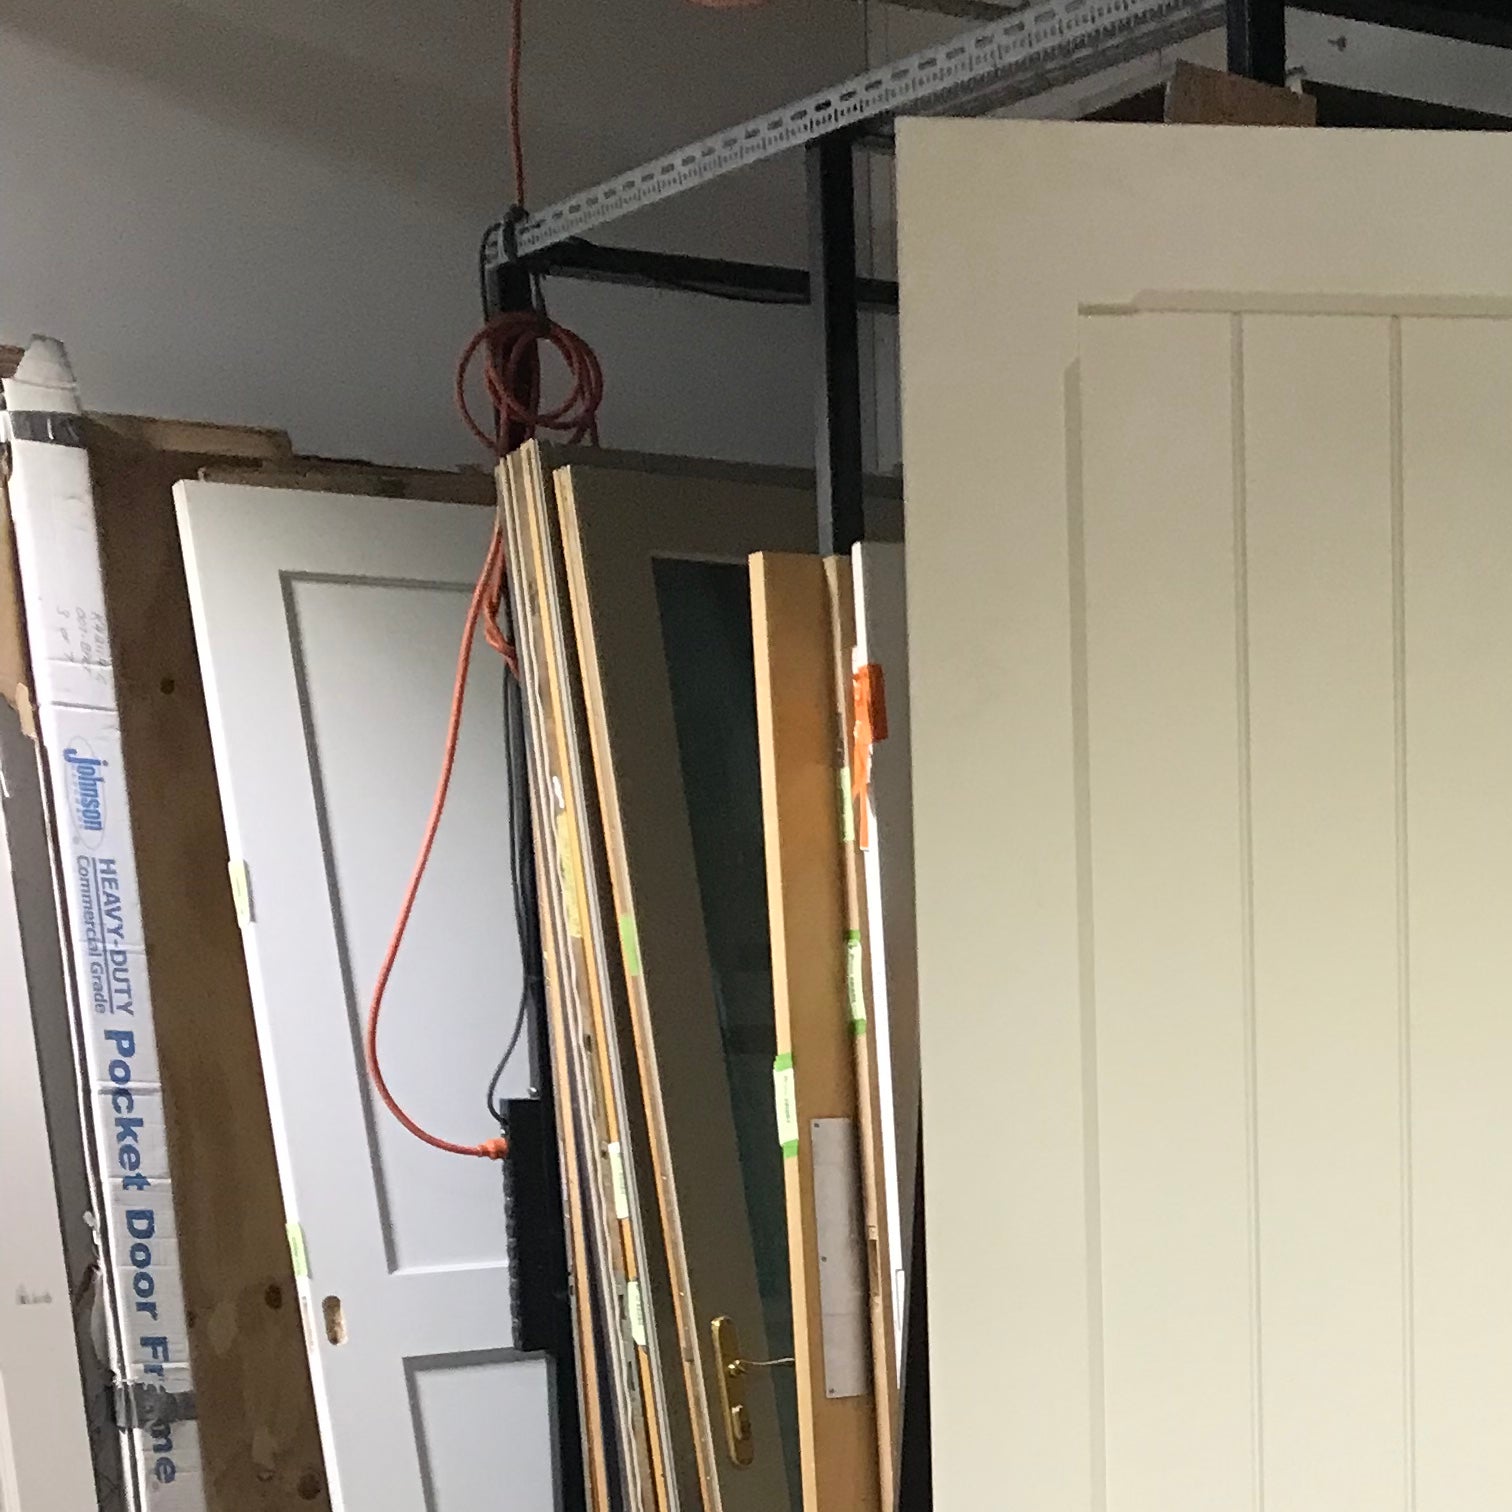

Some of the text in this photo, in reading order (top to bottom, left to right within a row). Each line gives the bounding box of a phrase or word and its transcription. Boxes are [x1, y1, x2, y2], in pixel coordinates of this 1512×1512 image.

[76, 855, 107, 1014] Commercial Grade
[99, 858, 134, 1017] HEAVY-DUTY
[104, 1029, 176, 1484] Pocket Door Frme
